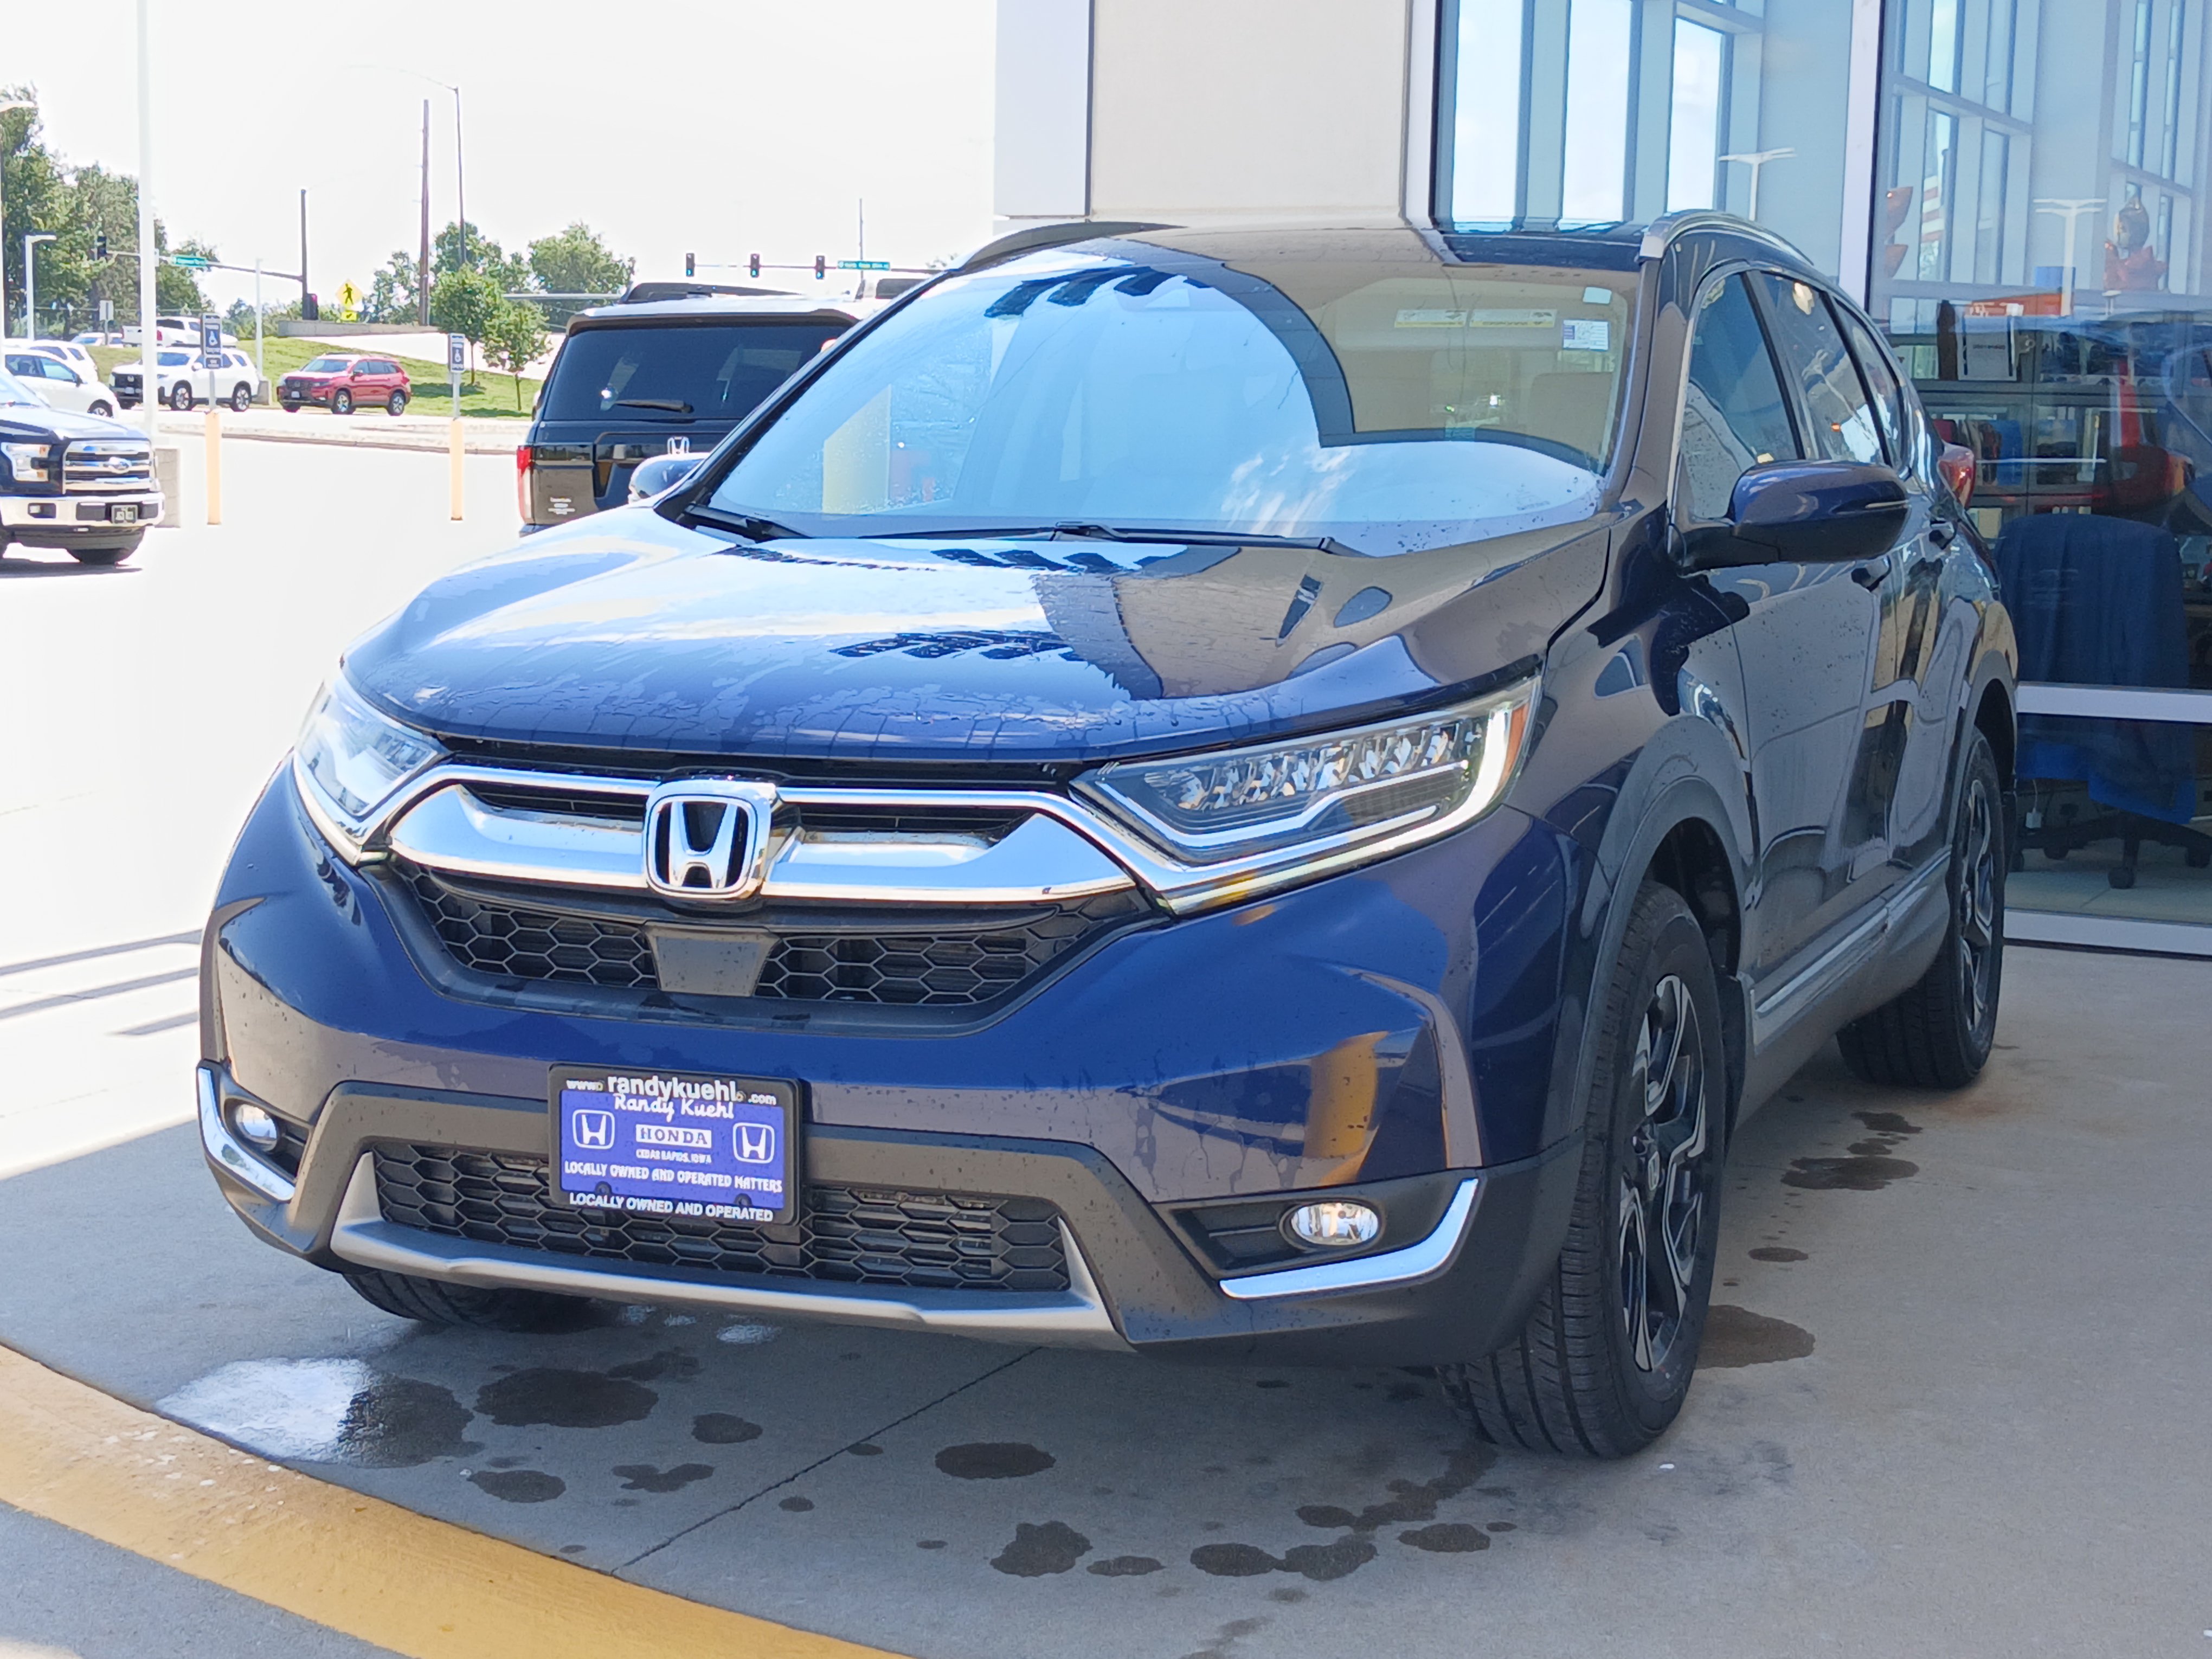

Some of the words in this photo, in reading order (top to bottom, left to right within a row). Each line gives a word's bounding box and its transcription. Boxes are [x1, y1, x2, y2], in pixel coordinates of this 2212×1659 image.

[608, 1075, 737, 1102] randykuehl
[613, 1093, 674, 1122] Randy
[681, 1097, 734, 1119] Kuehl
[640, 1127, 708, 1144] HONDA
[565, 1160, 607, 1177] LOCALLY
[610, 1165, 650, 1179] OWNED
[651, 1168, 674, 1181] AND
[677, 1171, 732, 1187] OPERATED
[734, 1175, 782, 1193] MATTERS
[570, 1192, 625, 1208] LOCALLY
[626, 1197, 673, 1213] OWNED
[675, 1202, 703, 1216] AND
[705, 1204, 774, 1222] OPERATED
